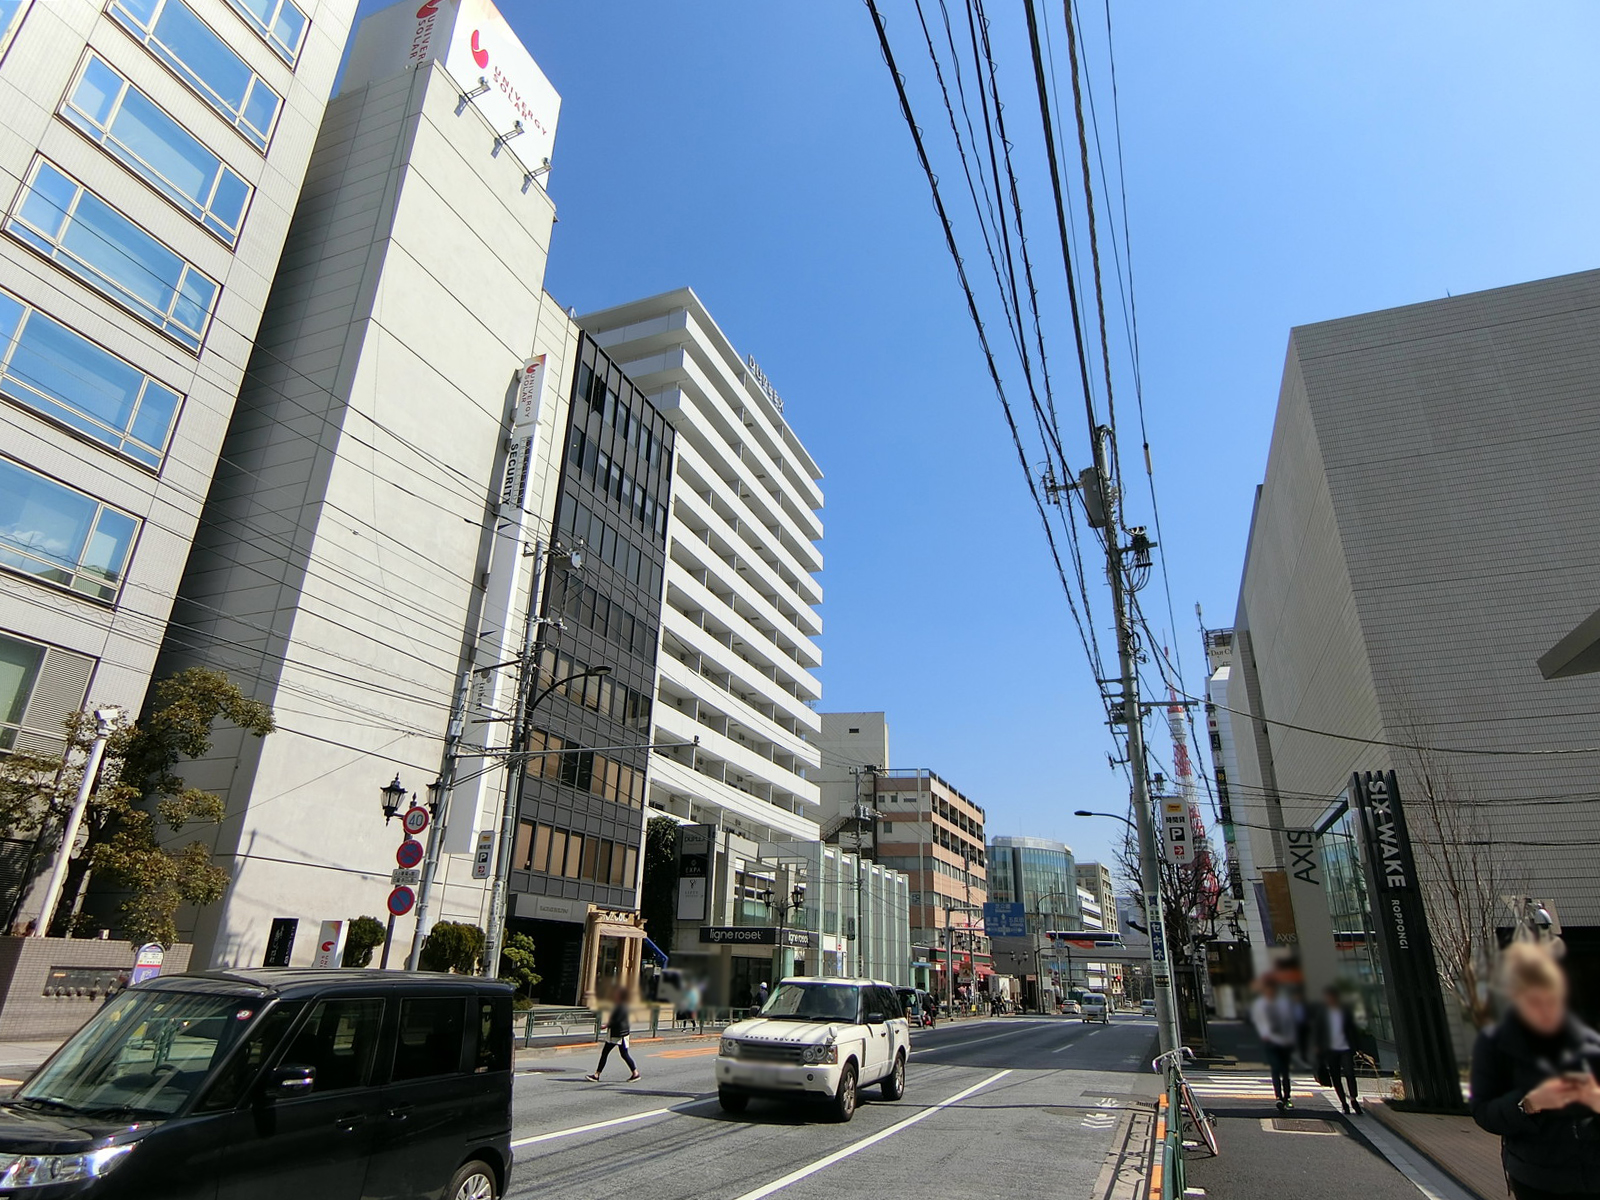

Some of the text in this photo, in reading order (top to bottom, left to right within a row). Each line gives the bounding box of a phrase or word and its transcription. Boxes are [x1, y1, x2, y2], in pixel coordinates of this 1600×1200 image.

[410, 20, 426, 59] SOLAR
[493, 74, 528, 120] SOLAR
[494, 66, 547, 136] UNIVERGY
[521, 375, 530, 404] SOLAR
[524, 374, 535, 418] UNIVERGY
[502, 443, 518, 506] SECURITY
[408, 815, 423, 826] 40
[1171, 828, 1182, 840] P
[479, 853, 487, 862] P
[1287, 831, 1320, 886] AXIS
[709, 929, 762, 941] ligne roset
[1151, 922, 1164, 960] セキネ
[1275, 932, 1297, 943] AXIS
[1391, 899, 1409, 950] ROPPONGI
